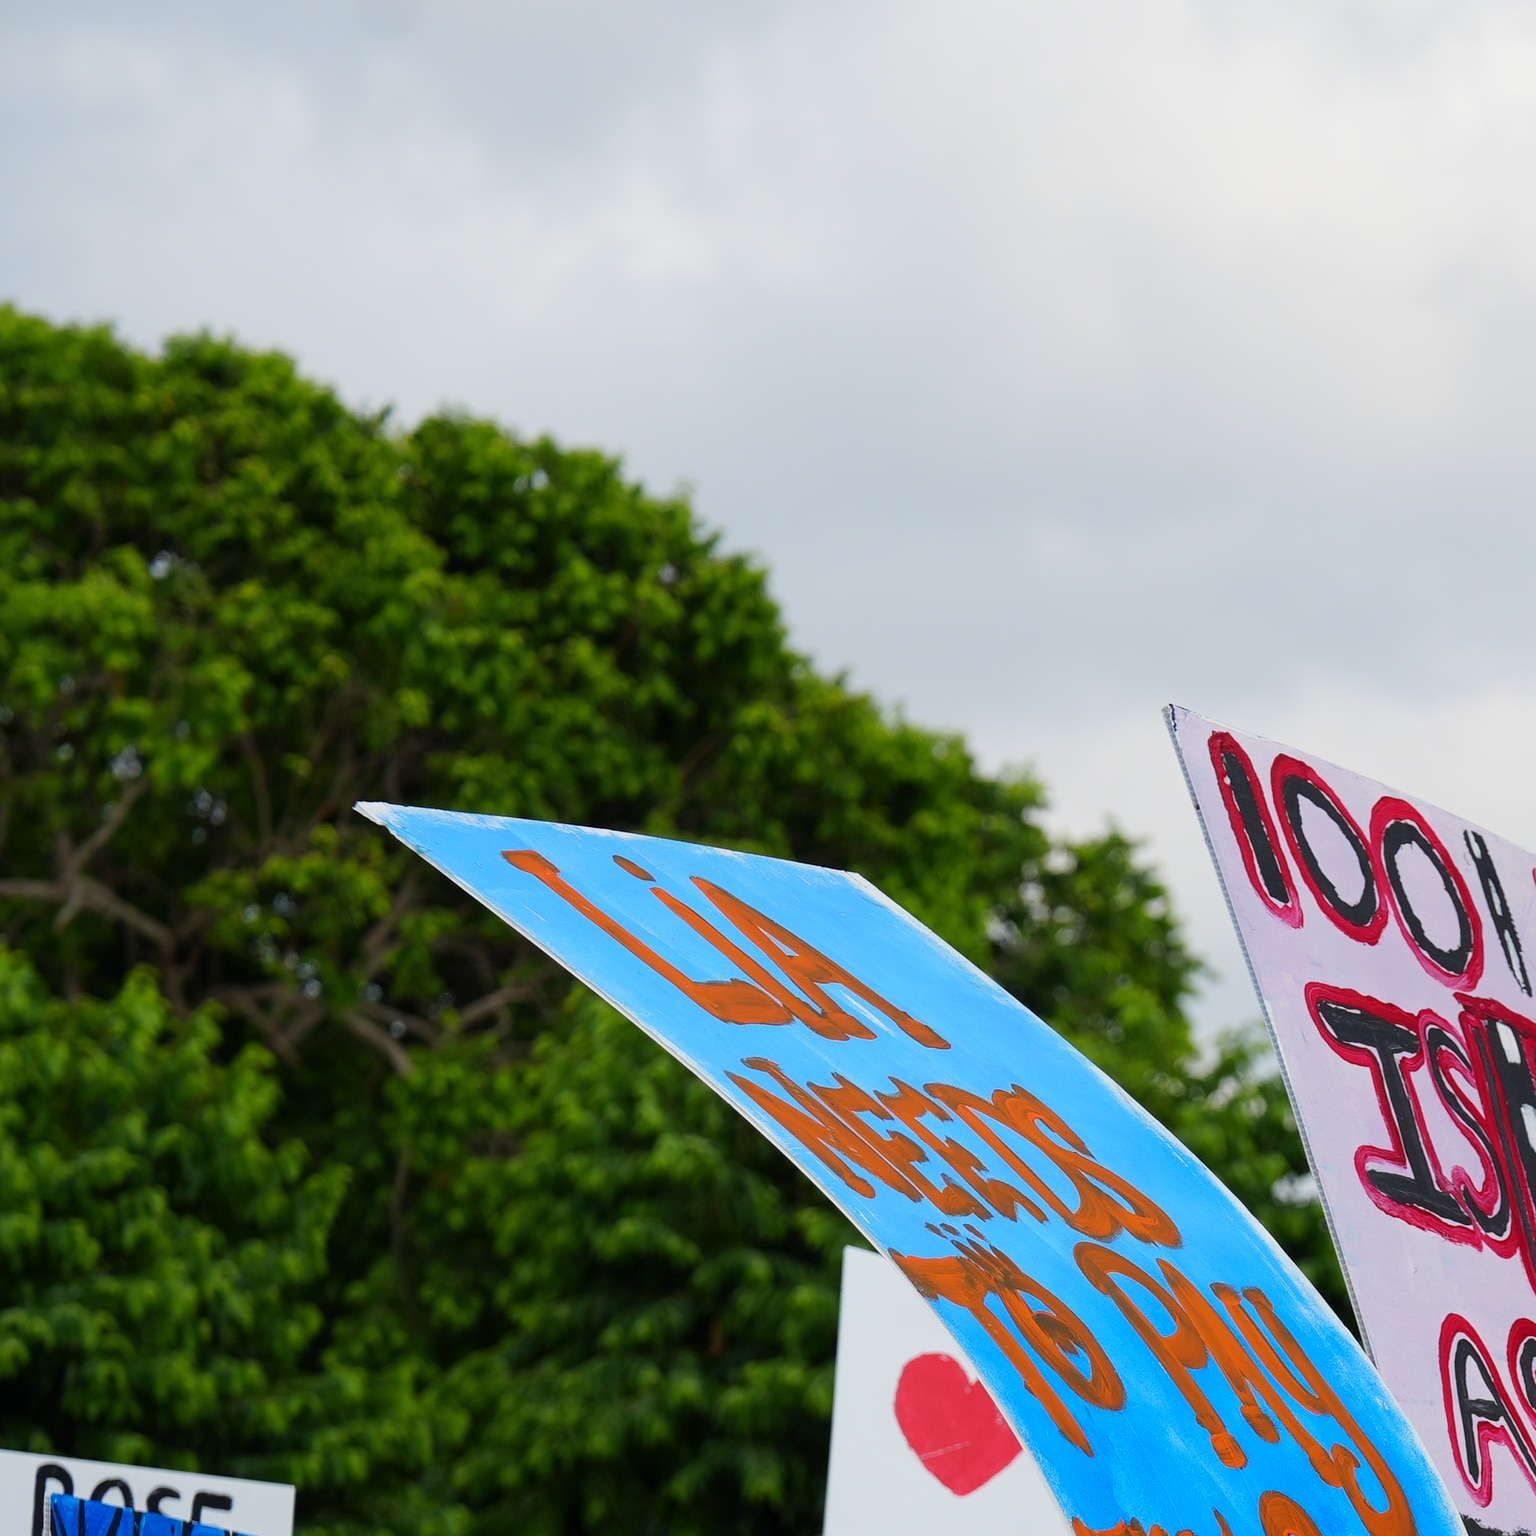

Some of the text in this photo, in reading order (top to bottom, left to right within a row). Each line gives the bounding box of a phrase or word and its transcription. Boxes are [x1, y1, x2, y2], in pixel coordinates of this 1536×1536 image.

[725, 1055, 1182, 1248] NEEDS
[1306, 982, 1519, 1258] IS
[891, 1246, 1124, 1456] TO
